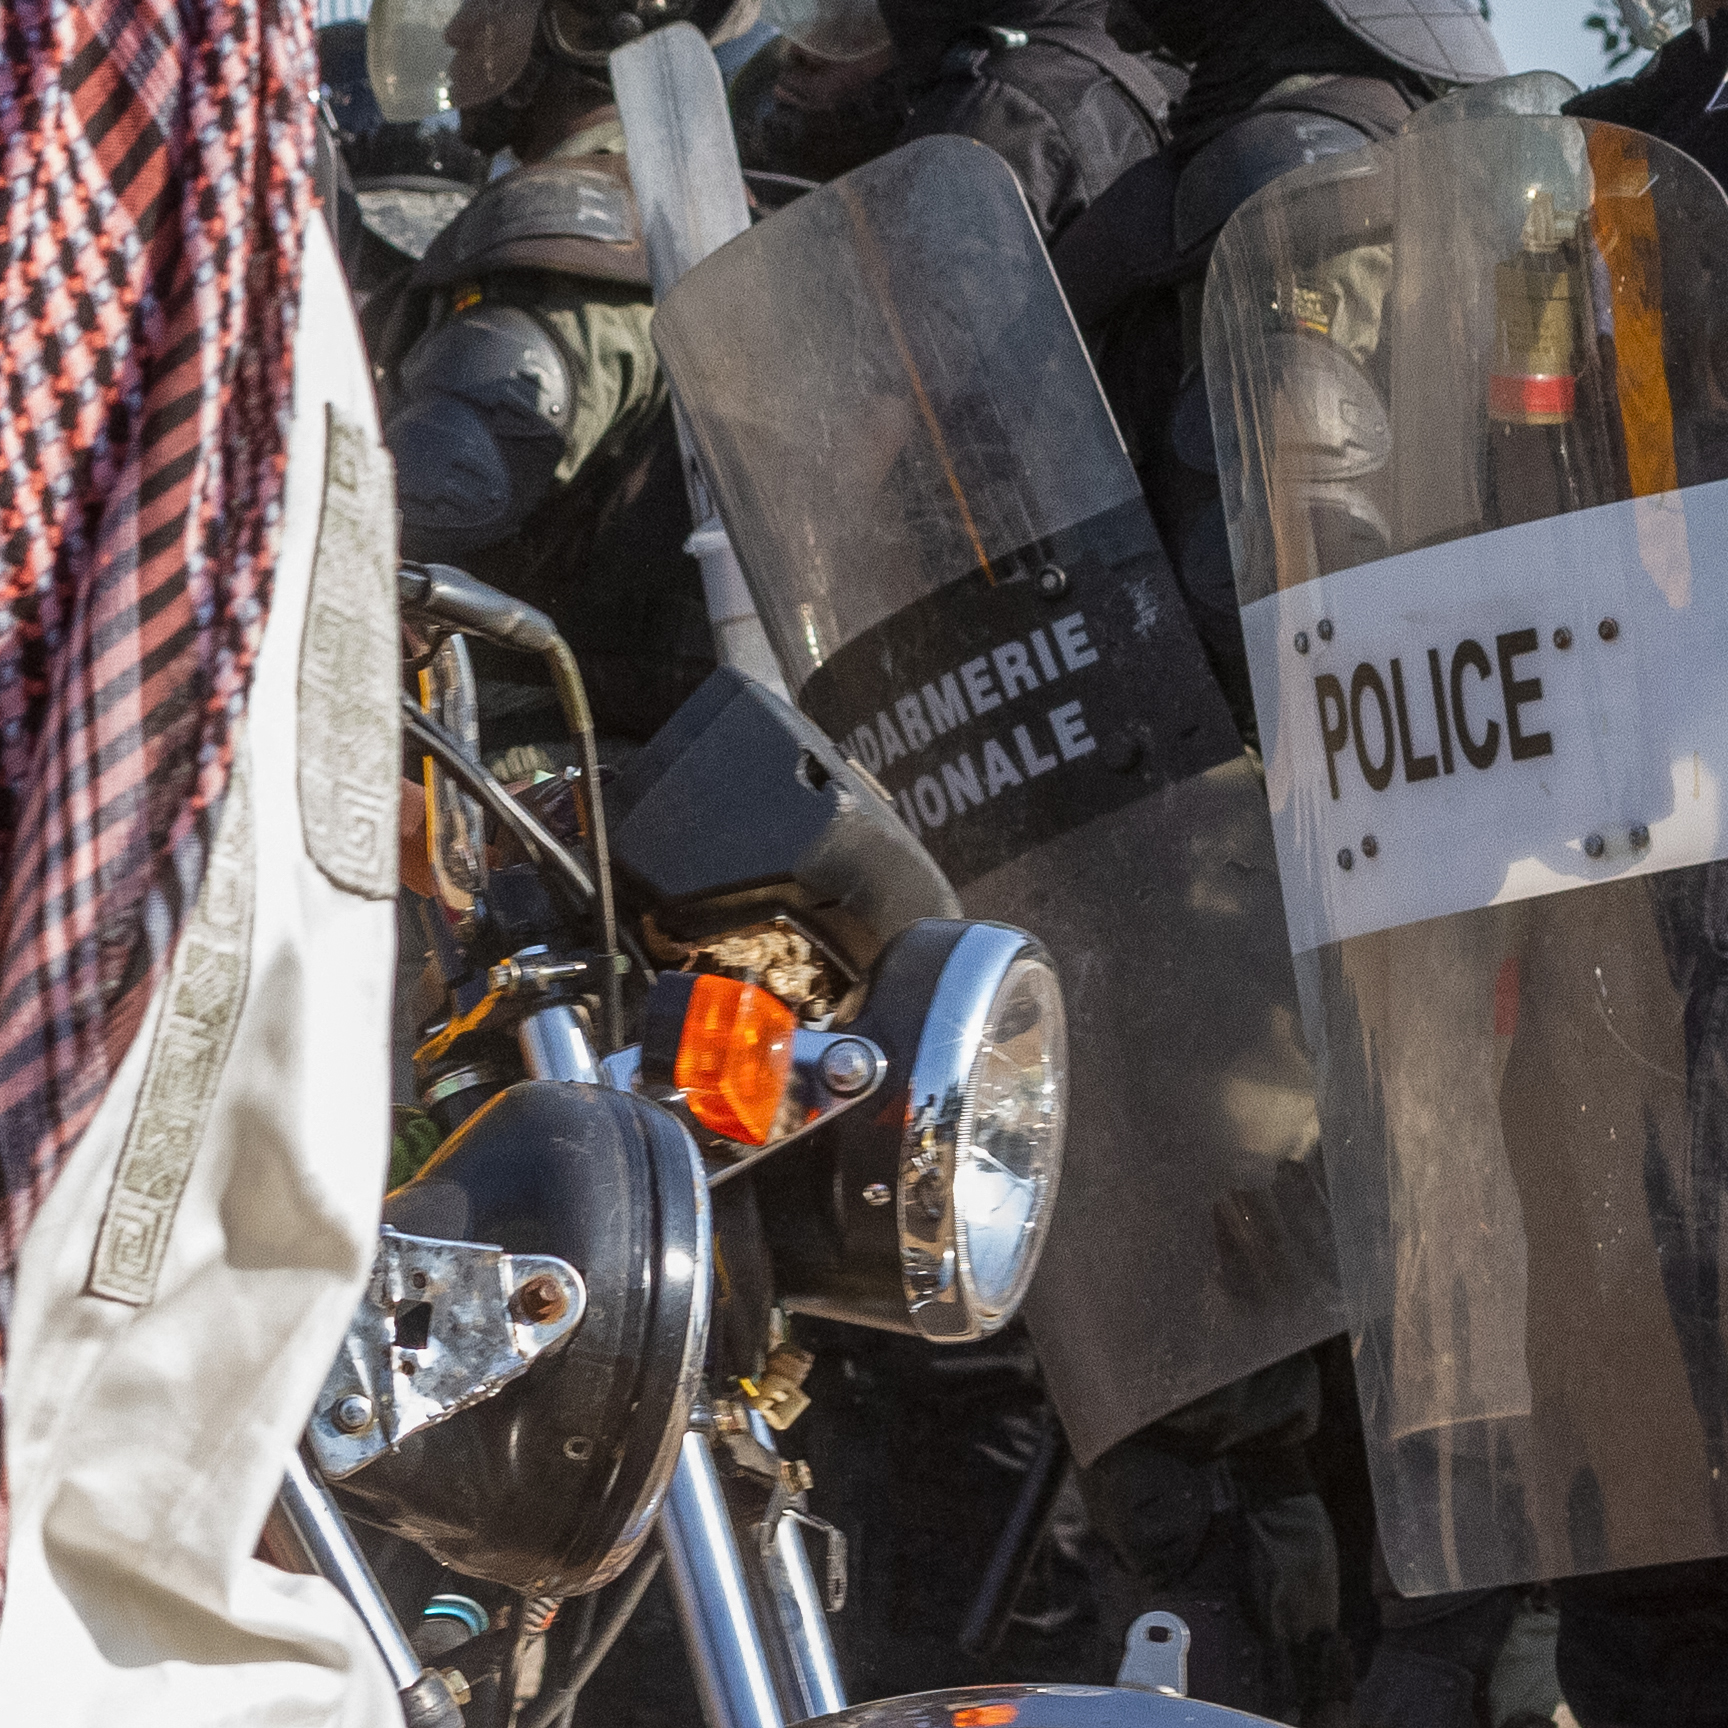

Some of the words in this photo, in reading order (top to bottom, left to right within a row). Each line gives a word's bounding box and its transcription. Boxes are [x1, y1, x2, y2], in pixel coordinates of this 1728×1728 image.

[836, 610, 1100, 774] NDARMERIE
[896, 699, 1098, 839] IONALE
[1314, 627, 1554, 801] POLICE
